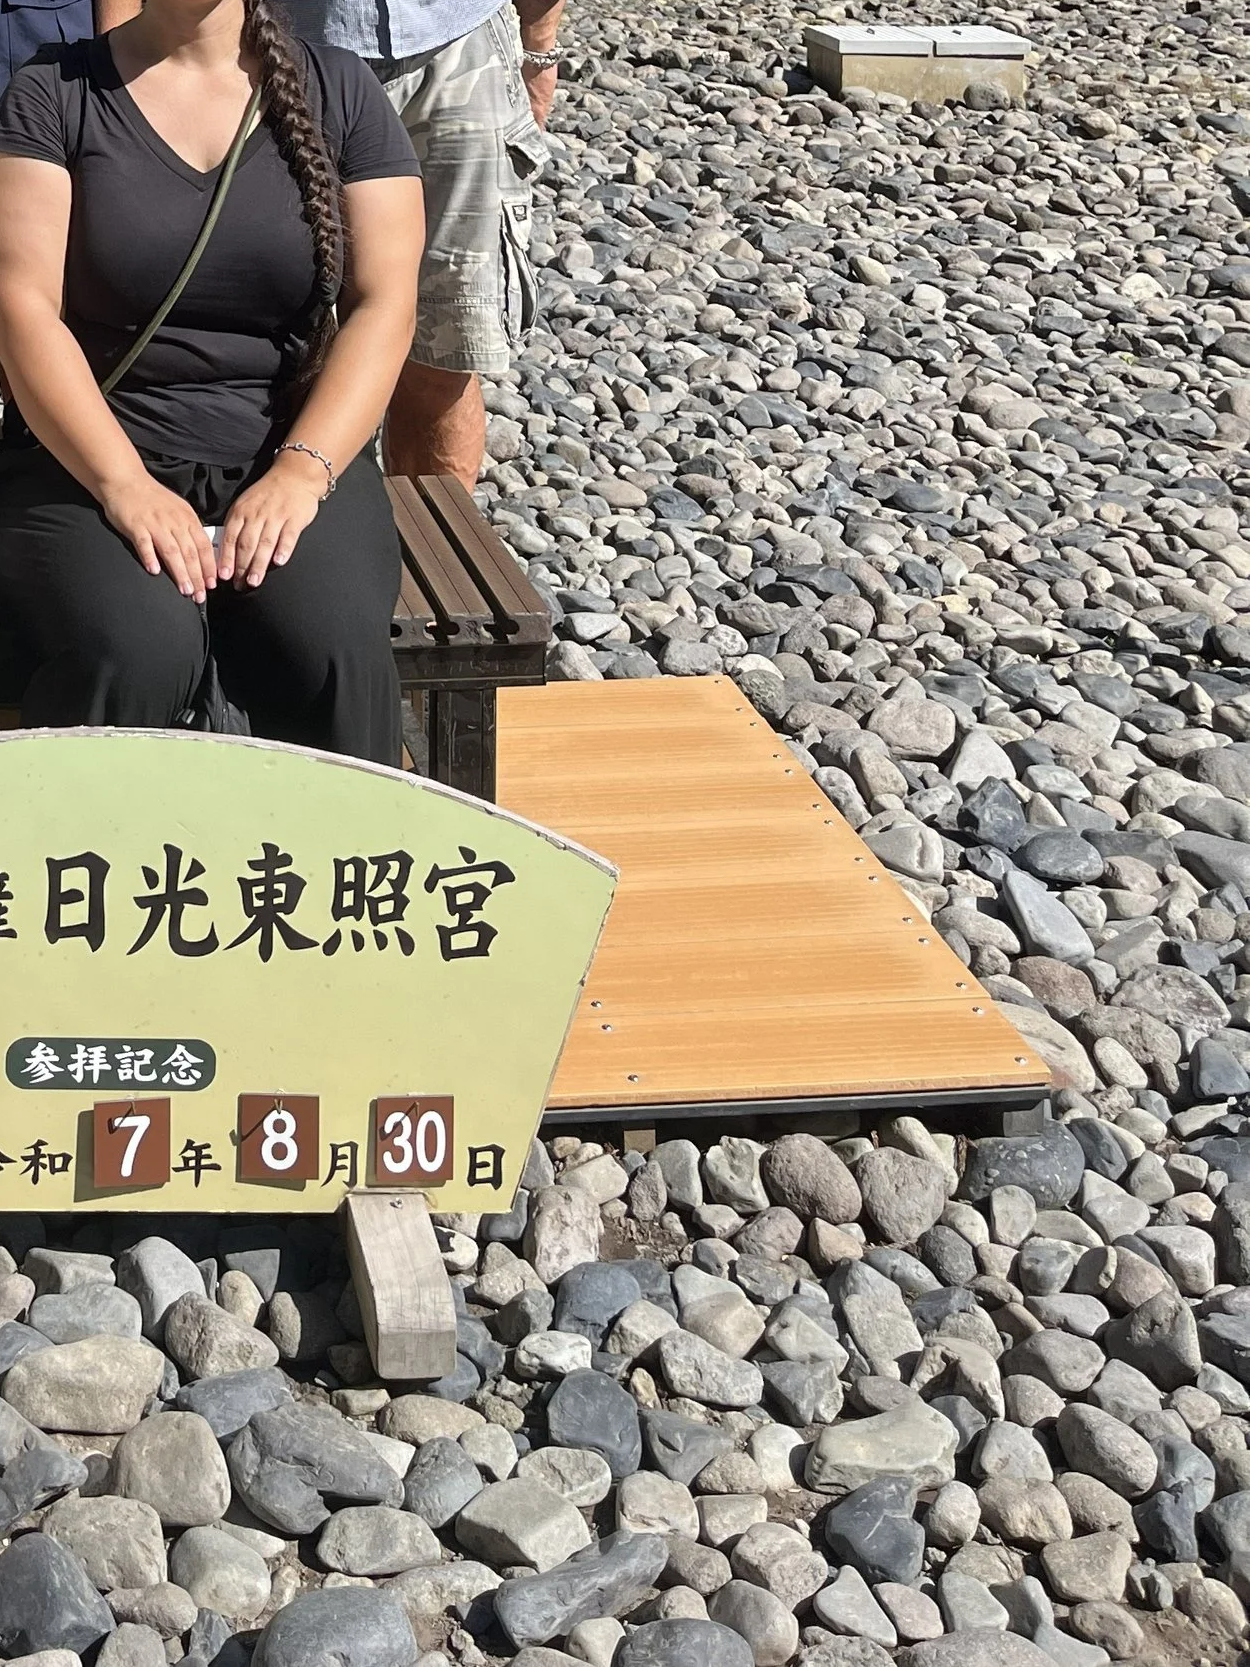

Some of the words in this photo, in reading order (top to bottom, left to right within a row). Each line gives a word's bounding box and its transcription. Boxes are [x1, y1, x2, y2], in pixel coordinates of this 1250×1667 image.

[44, 841, 517, 962] 日光東照宮
[20, 1041, 206, 1086] 参拝記念
